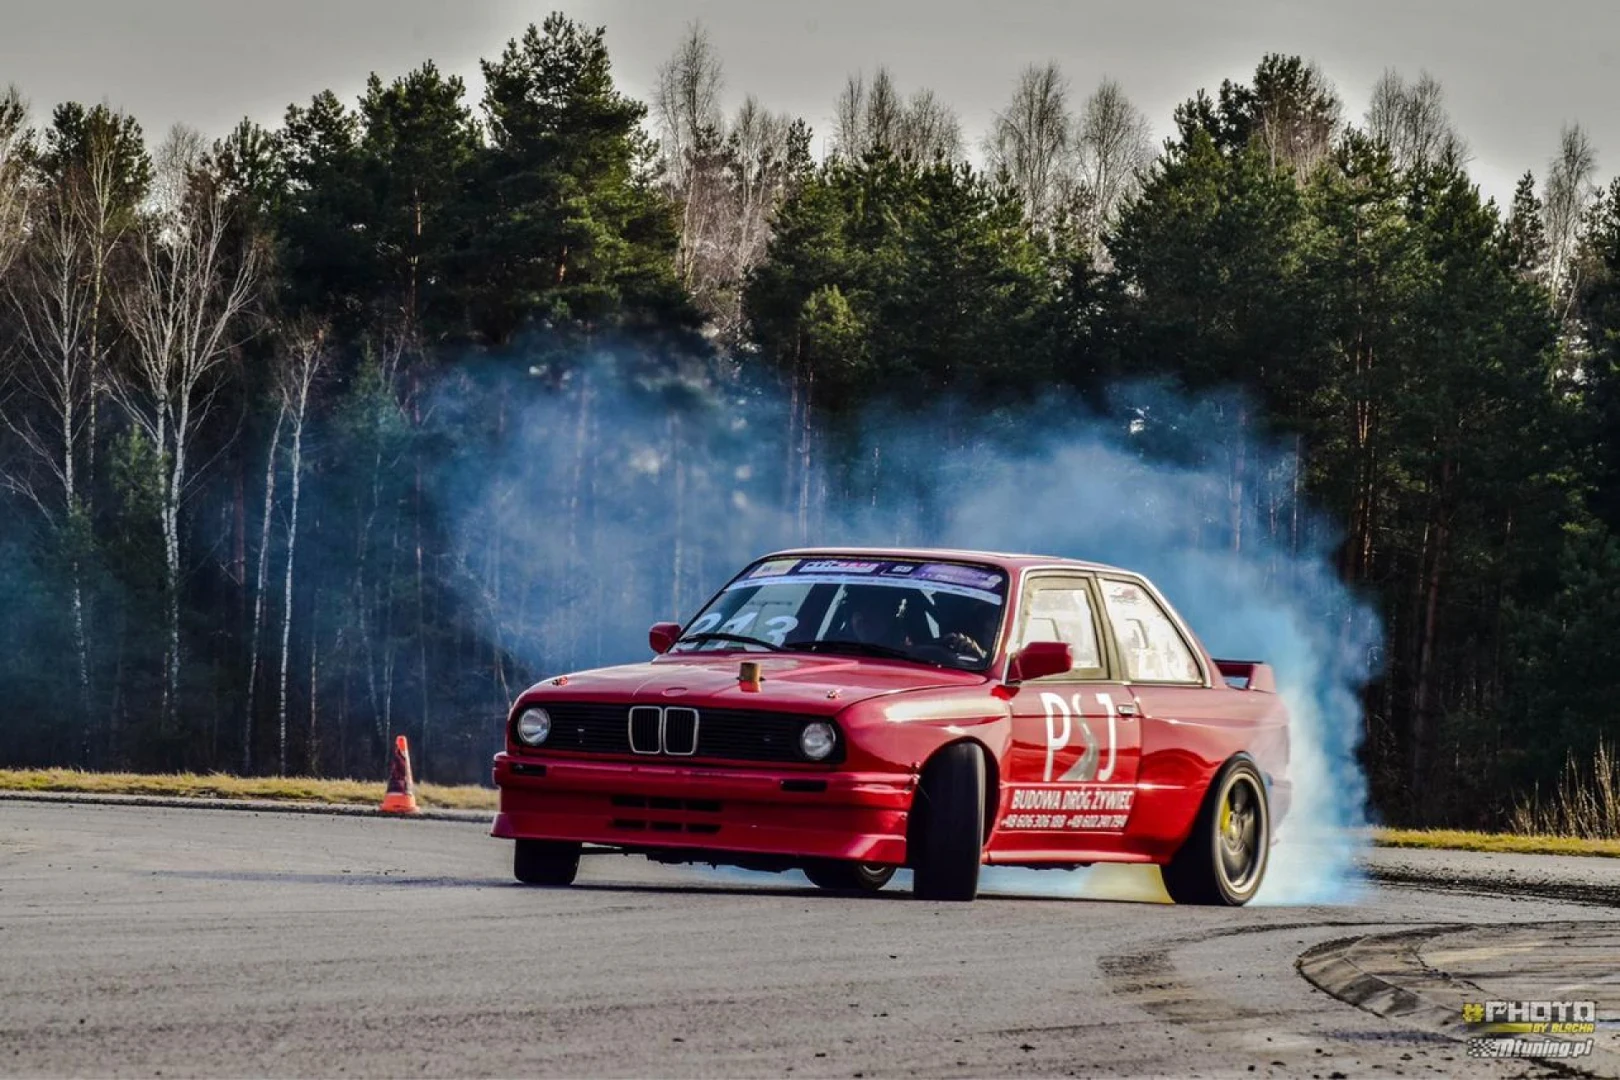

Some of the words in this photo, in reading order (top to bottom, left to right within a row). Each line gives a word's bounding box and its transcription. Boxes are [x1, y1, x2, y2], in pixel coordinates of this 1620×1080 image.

[1040, 692, 1116, 782] PSJ
[1011, 790, 1061, 809] BUDOWA
[1061, 787, 1092, 810] DRÓG
[1090, 787, 1134, 810] ŻYWIEC
